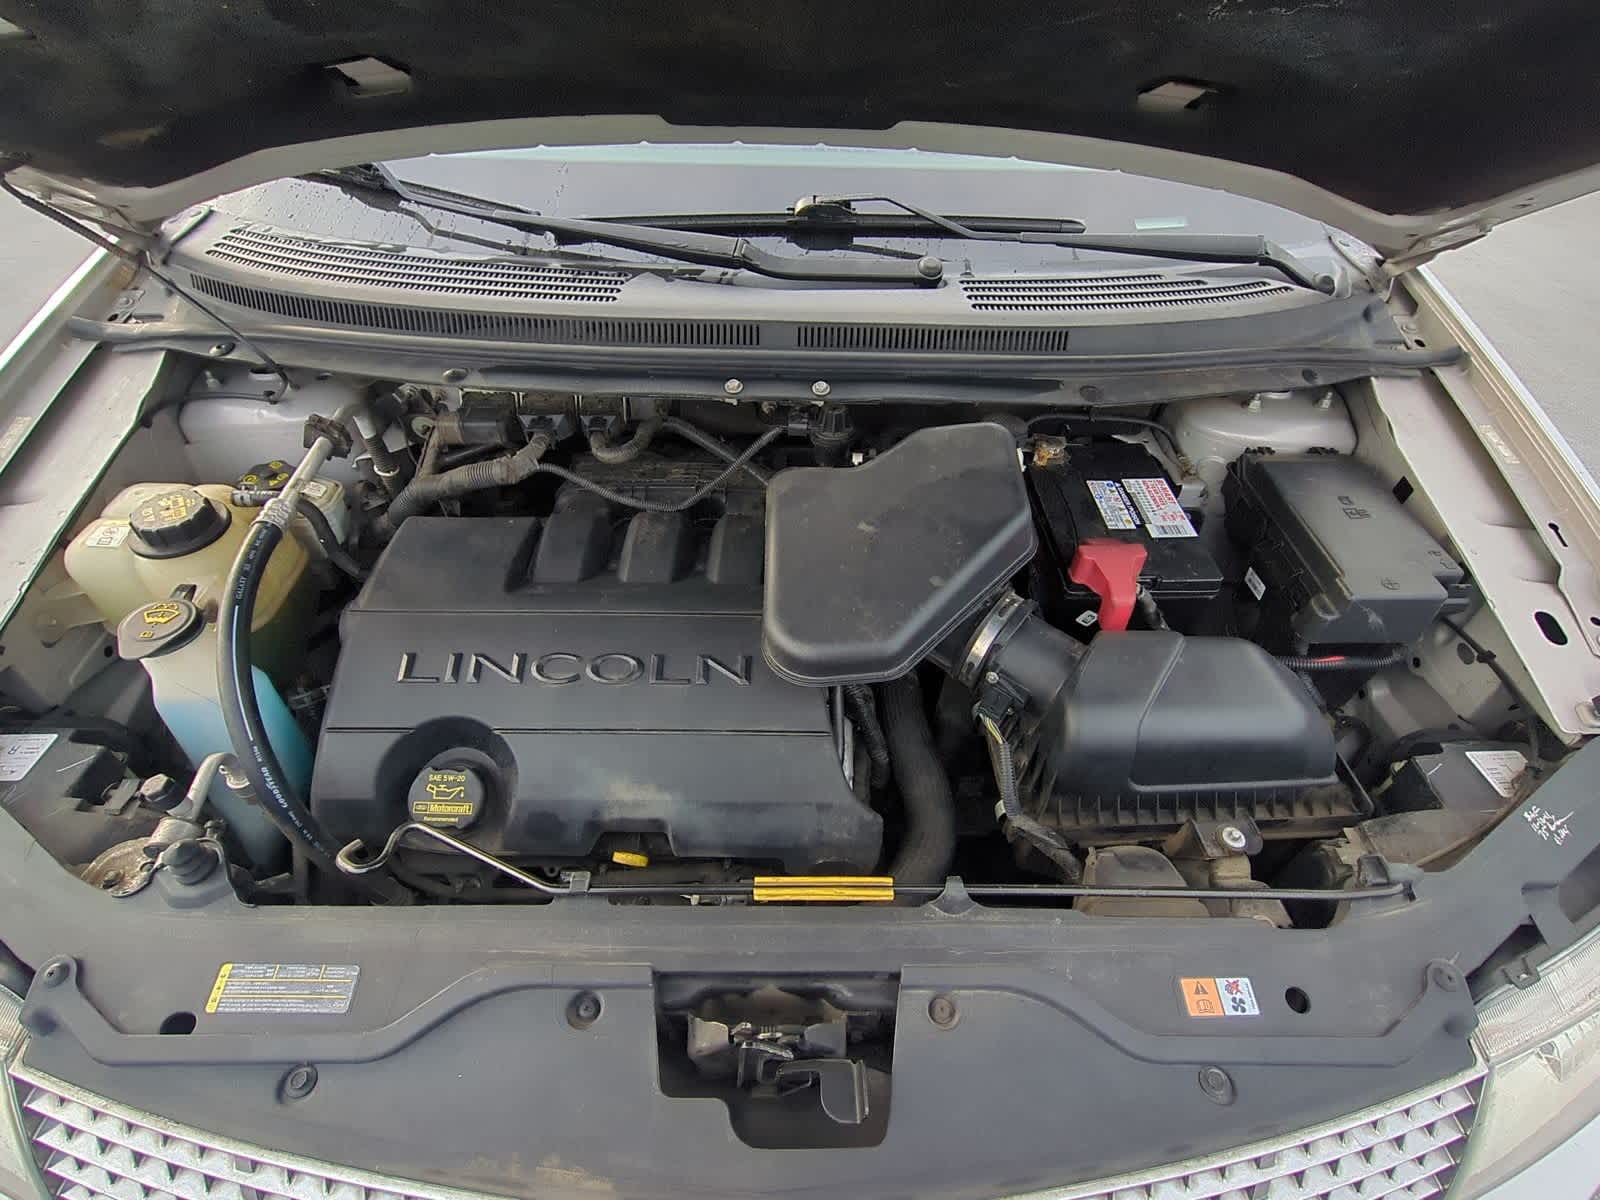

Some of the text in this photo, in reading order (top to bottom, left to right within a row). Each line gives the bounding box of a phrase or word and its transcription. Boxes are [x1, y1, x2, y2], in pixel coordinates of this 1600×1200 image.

[397, 651, 752, 686] LINCOLN
[261, 767, 288, 808] GOODYEAR
[429, 774, 466, 783] SAE 5W-20
[429, 804, 470, 813] Motorcraft
